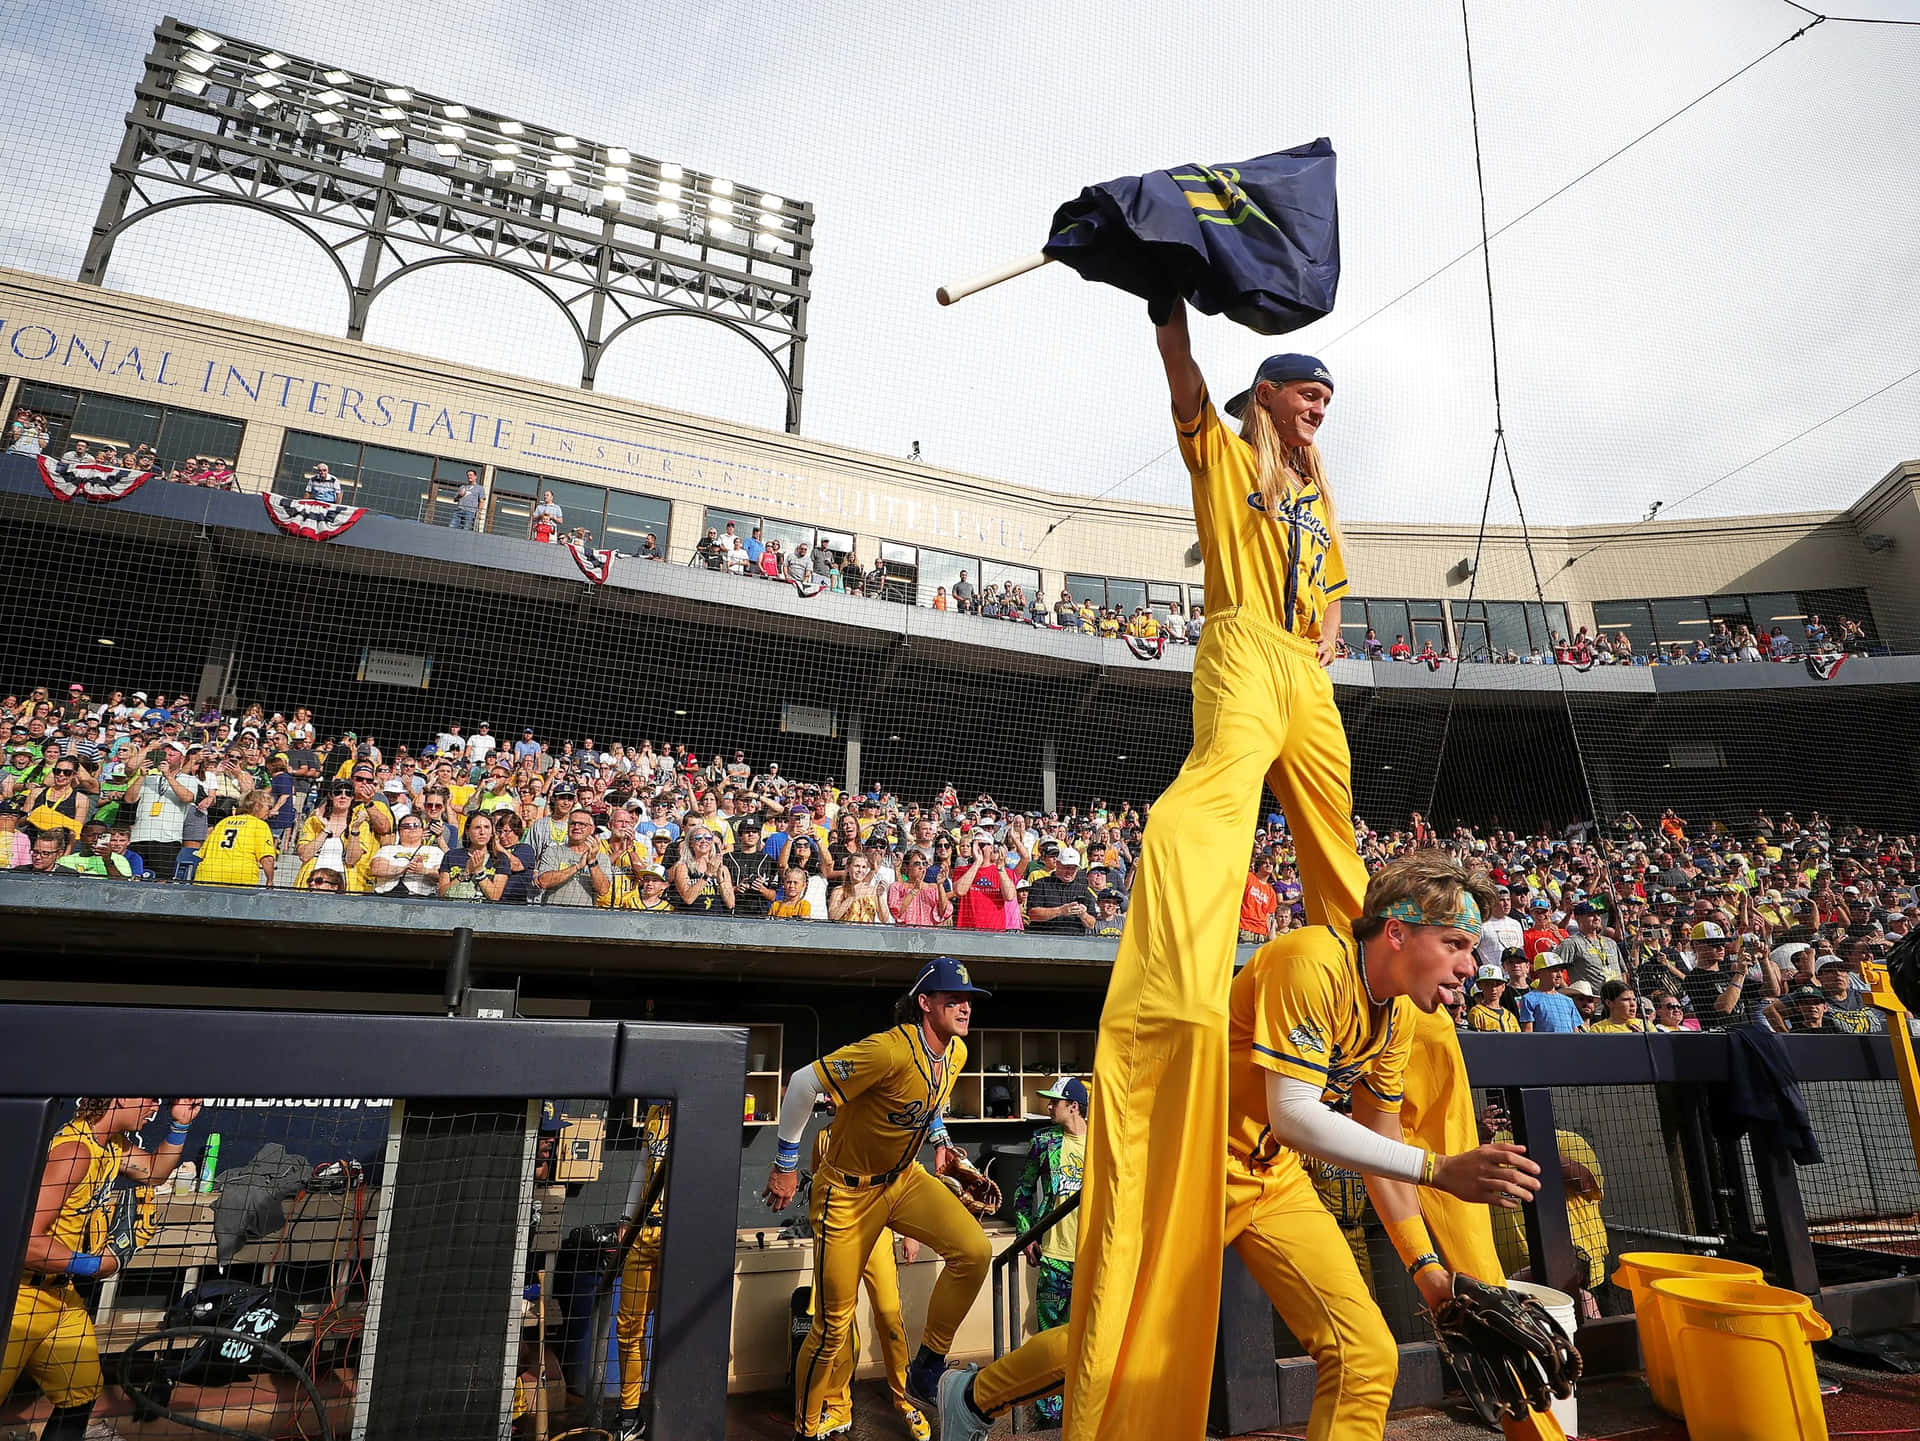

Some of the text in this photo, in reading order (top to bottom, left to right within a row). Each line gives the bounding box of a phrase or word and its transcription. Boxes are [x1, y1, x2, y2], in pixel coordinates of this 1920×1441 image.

[200, 361, 513, 450] INTERSTATE
[529, 432, 798, 498] INSURANCE
[220, 828, 239, 849] 3
